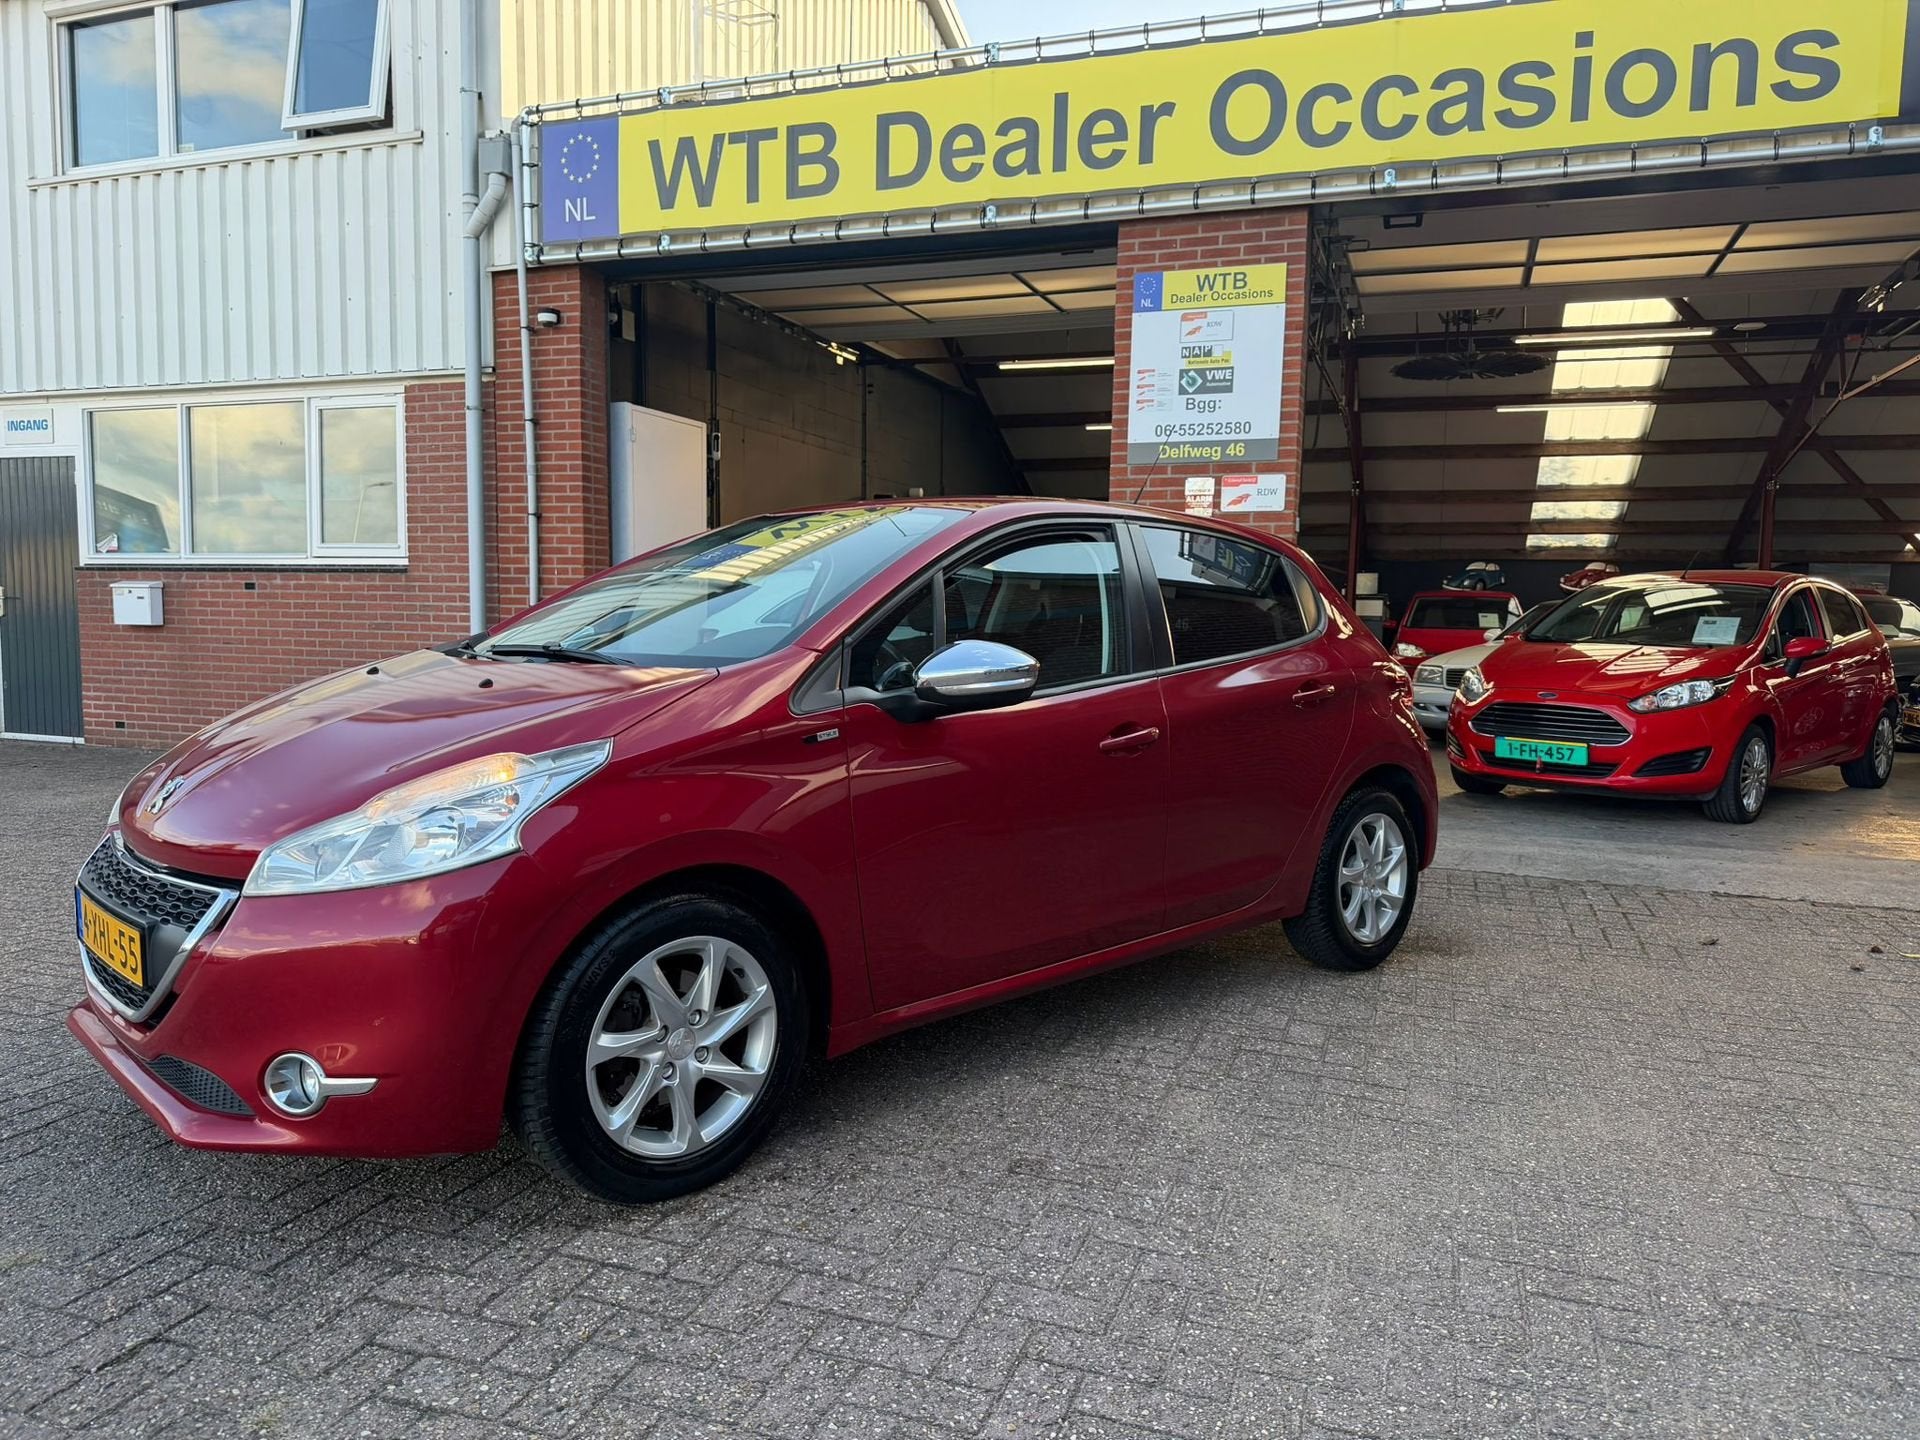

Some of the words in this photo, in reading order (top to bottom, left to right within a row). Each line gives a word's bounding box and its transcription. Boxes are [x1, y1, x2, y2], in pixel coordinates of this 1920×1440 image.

[648, 122, 839, 210] WTB
[875, 92, 1175, 190] Dealer
[1209, 29, 1841, 157] Occasions
[564, 197, 596, 223] NL
[1196, 271, 1248, 292] WTB
[1140, 298, 1153, 308] NL
[1170, 292, 1207, 304] Dealer
[1210, 288, 1274, 302] Occasions
[1182, 345, 1211, 358] NAP
[1206, 369, 1233, 380] VWE
[1185, 397, 1222, 413] Bgg:
[7, 419, 49, 432] INGANG
[1155, 421, 1252, 437] 06-55252580
[1159, 443, 1222, 460] Delfweg
[1226, 443, 1245, 457] 46
[1257, 488, 1279, 496] RDW
[1507, 742, 1575, 762] 1-FH-457
[83, 903, 139, 975] 4-XHL-55
